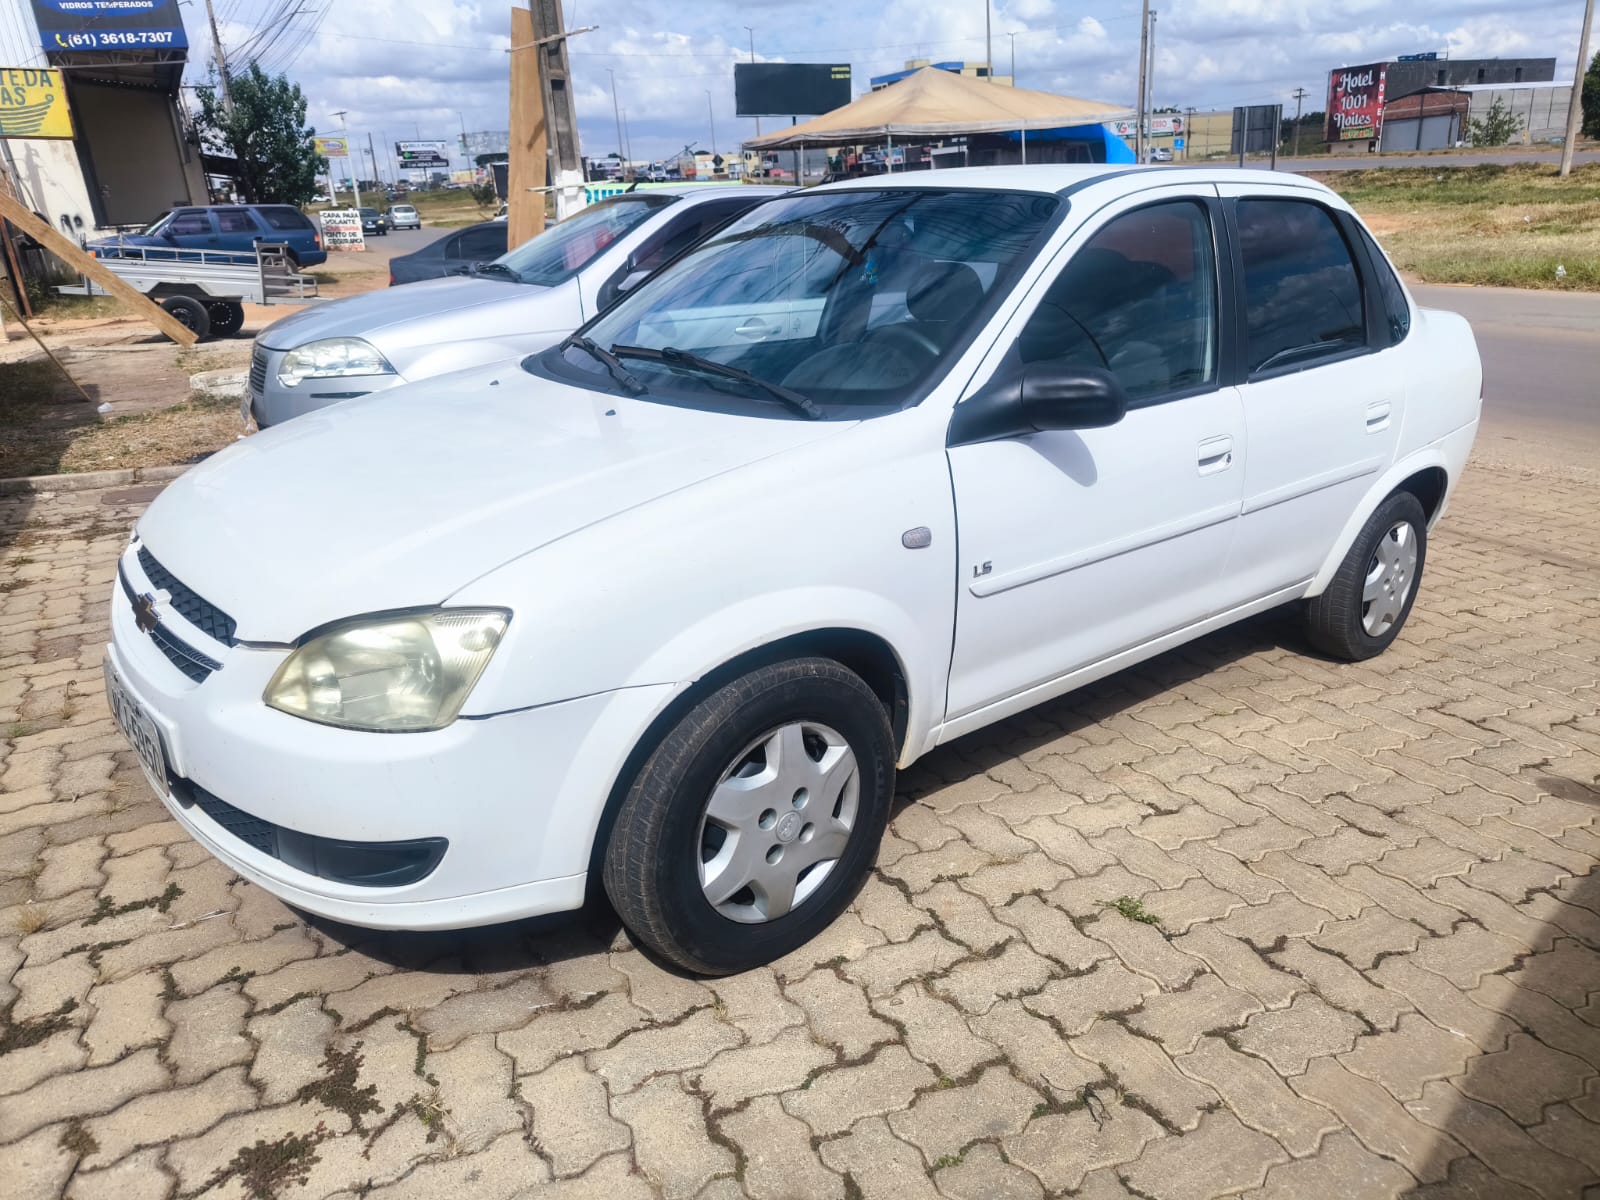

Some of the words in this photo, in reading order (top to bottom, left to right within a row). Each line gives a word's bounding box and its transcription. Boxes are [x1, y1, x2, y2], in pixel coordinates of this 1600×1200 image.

[94, 1, 154, 9] TEMPERADOS
[68, 33, 97, 48] (61)
[100, 31, 173, 45] 3618-7307
[1336, 69, 1374, 93] Hotel
[1340, 94, 1368, 111] 1001
[1376, 71, 1386, 128] HOTEL
[1333, 112, 1372, 129] Noites
